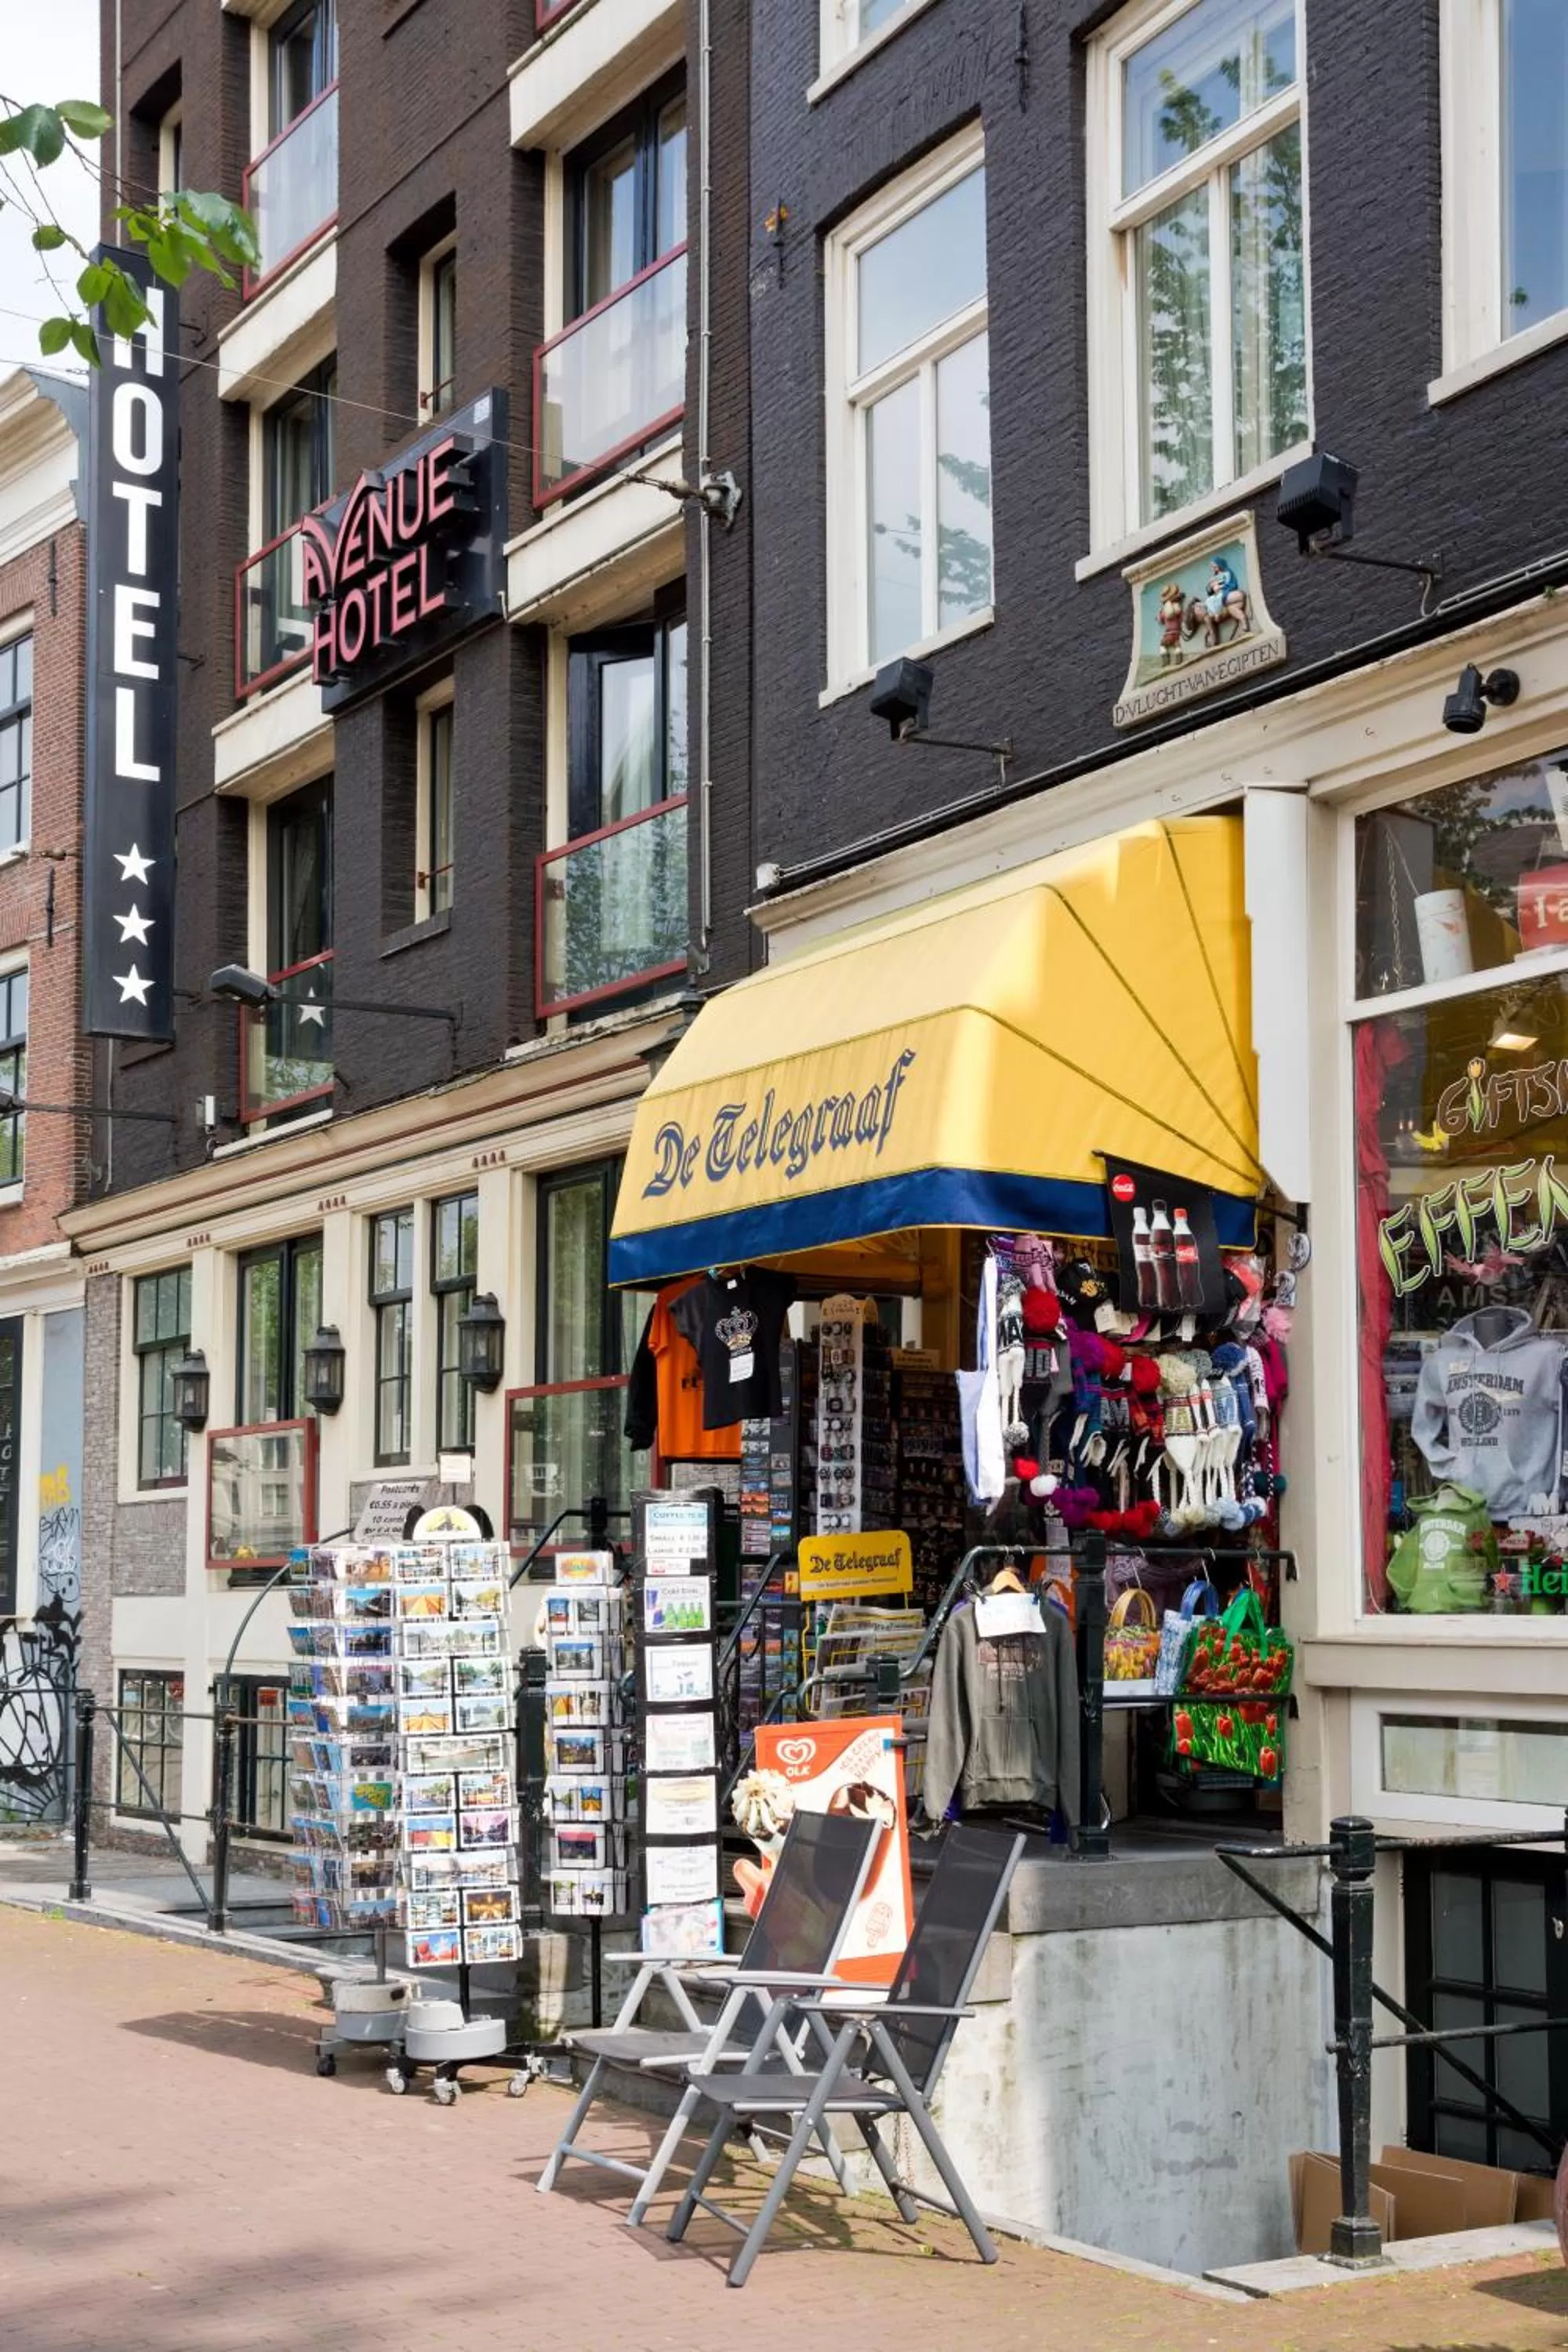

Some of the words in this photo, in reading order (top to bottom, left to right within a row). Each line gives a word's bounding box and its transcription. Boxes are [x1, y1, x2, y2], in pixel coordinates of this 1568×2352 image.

[112, 286, 164, 782] HOTEL
[302, 435, 456, 607] AVENUE
[312, 545, 447, 686] HOTEL
[641, 1121, 701, 1200] De
[706, 1049, 916, 1180] Telegraaf
[810, 1555, 831, 1573] De
[833, 1547, 902, 1572] Telegraaf
